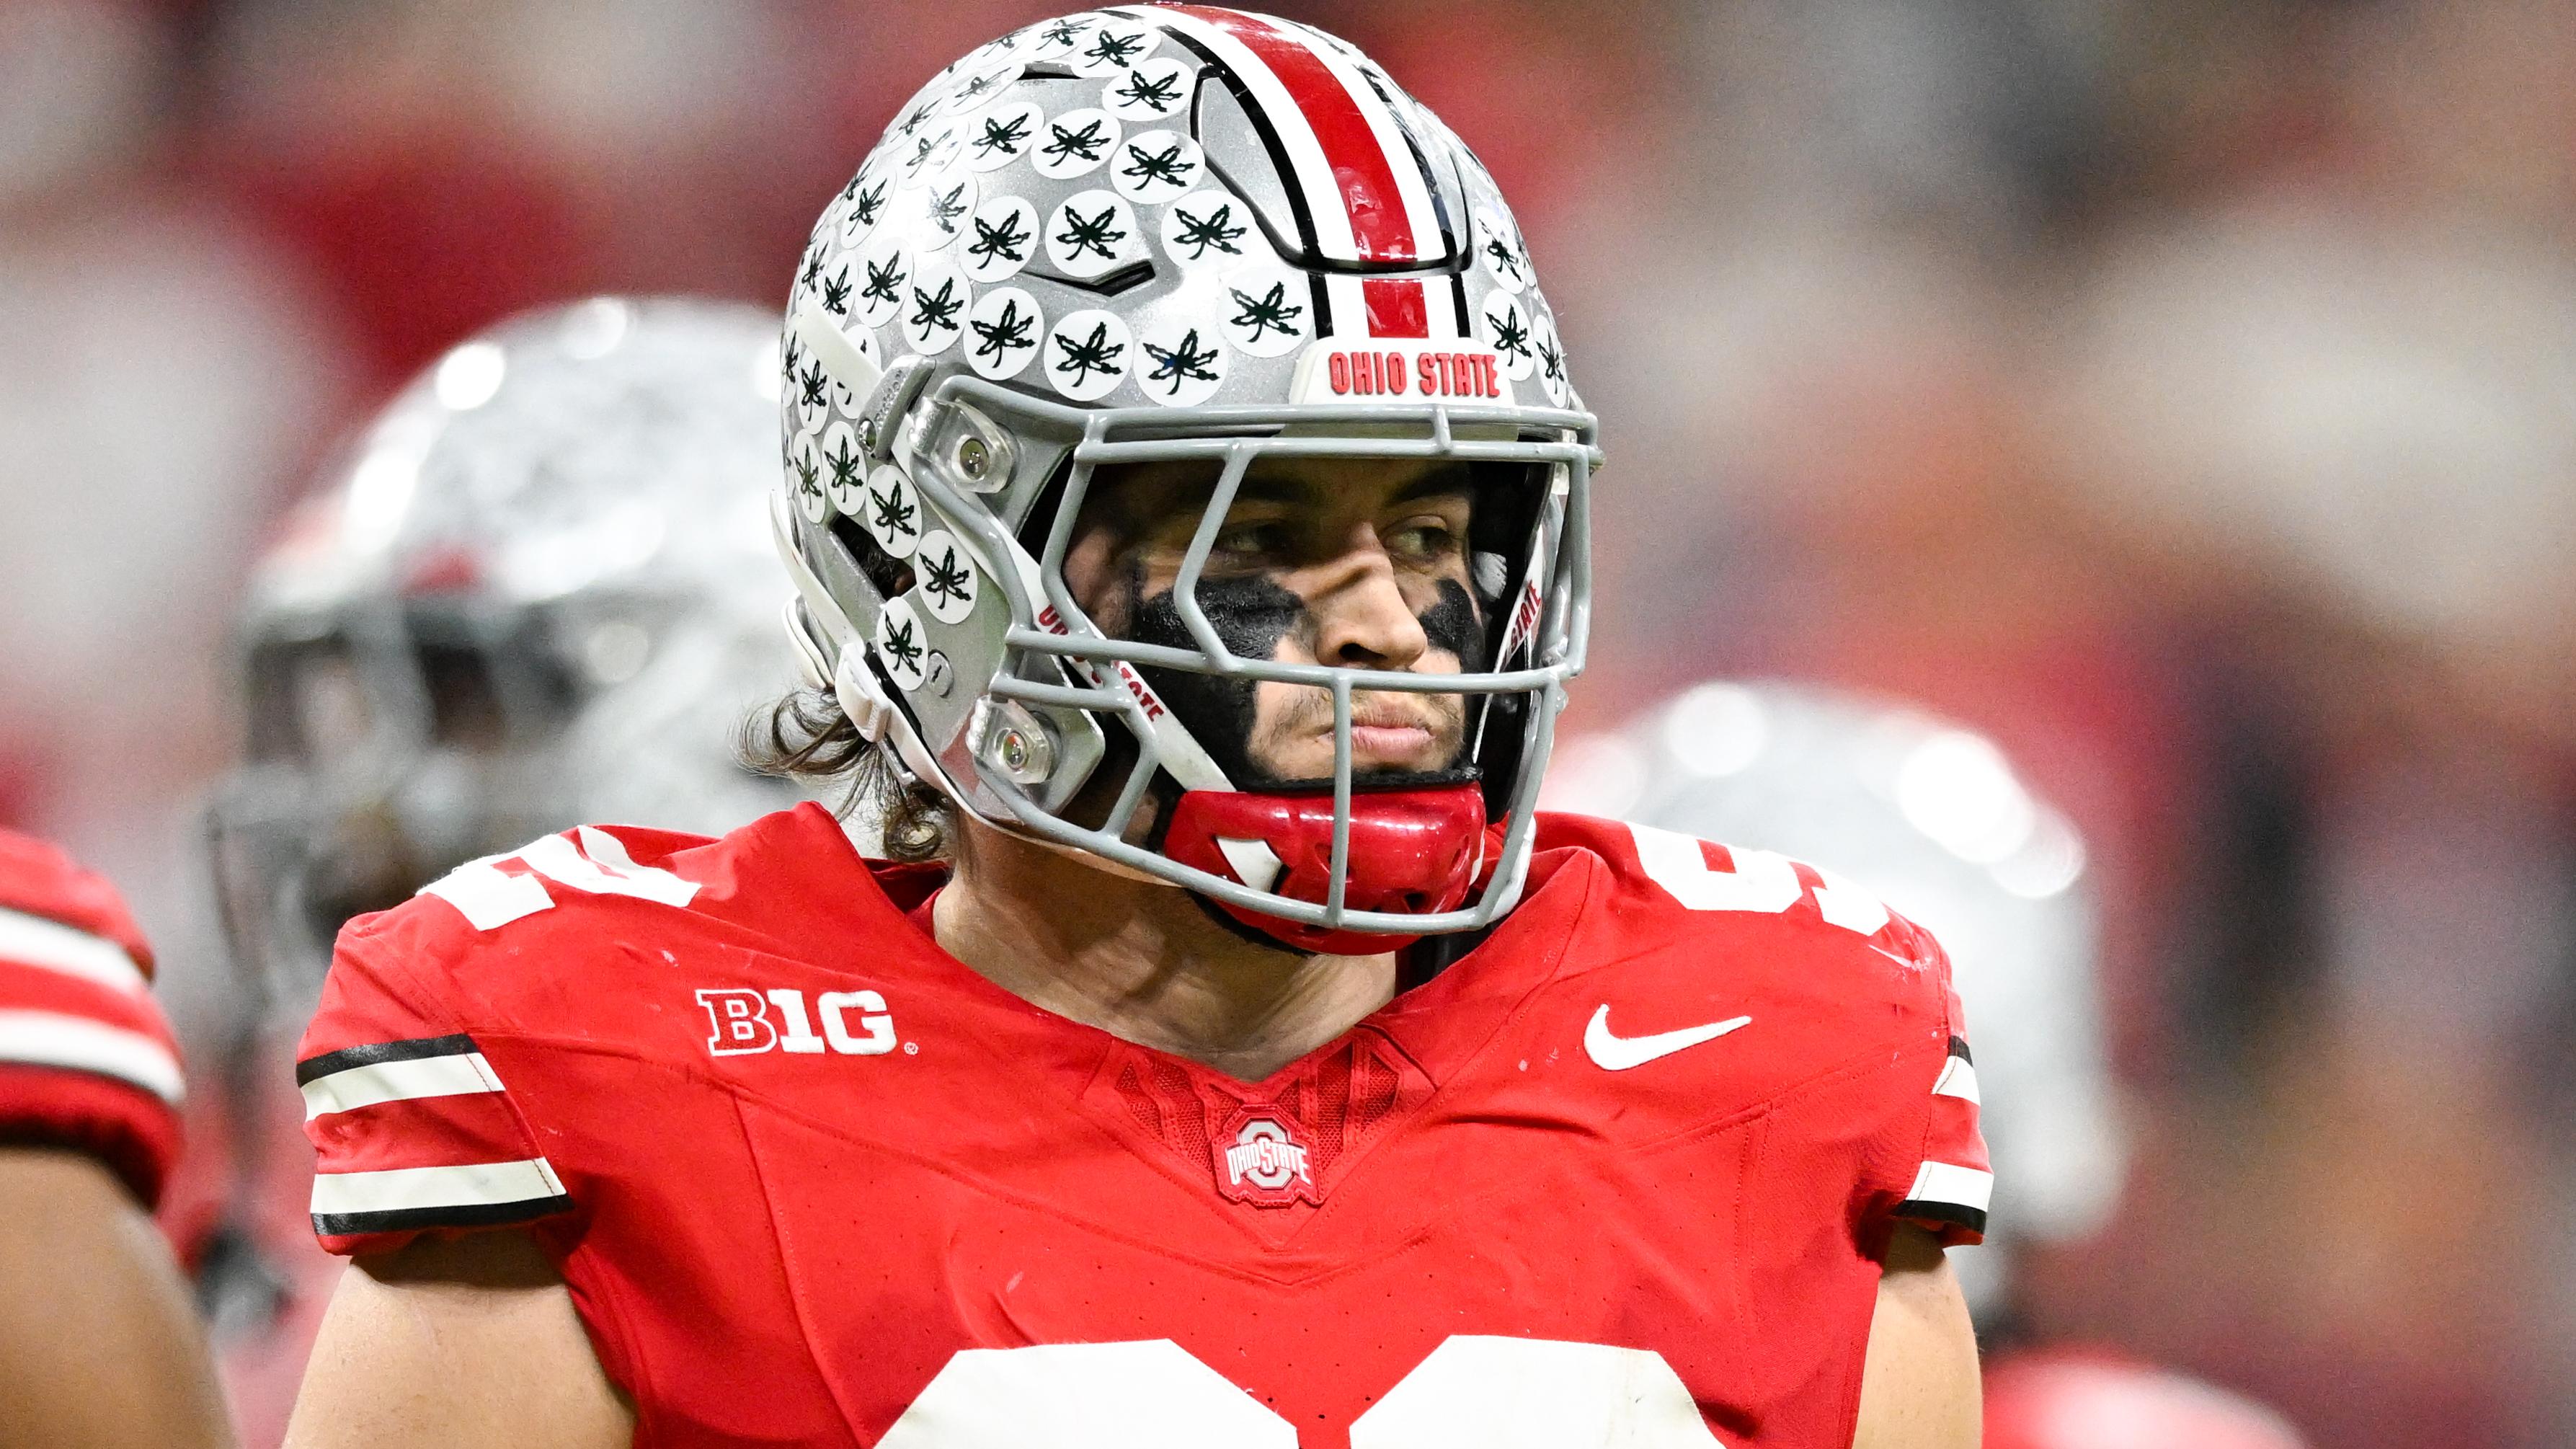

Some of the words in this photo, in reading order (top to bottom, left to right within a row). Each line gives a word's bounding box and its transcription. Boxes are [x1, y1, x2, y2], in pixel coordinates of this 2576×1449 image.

[1328, 351, 1408, 396] OHIO
[1418, 352, 1501, 398] STATE
[1511, 579, 1543, 654] STATE
